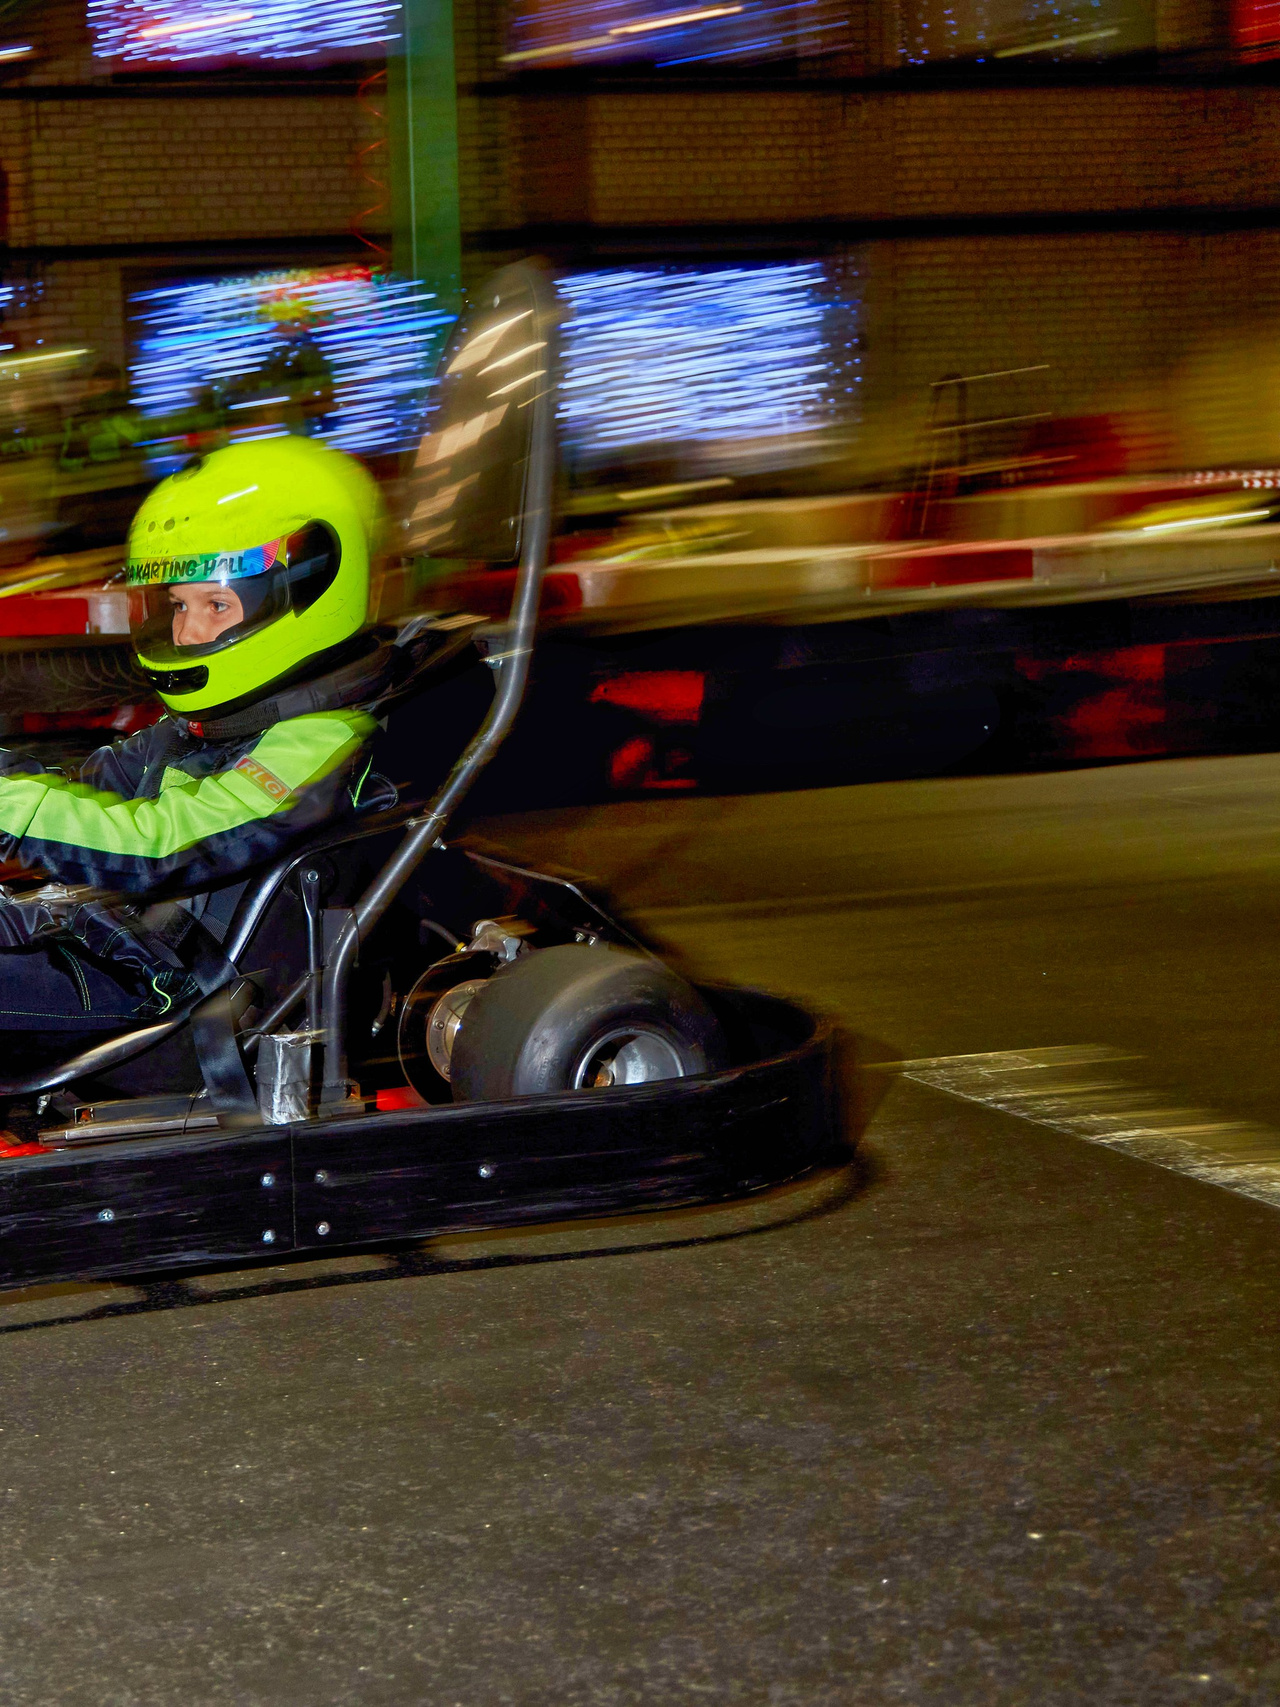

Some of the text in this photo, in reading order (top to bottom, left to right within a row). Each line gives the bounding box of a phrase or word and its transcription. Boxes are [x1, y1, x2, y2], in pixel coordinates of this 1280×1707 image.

[136, 559, 197, 581] KARTING
[203, 556, 248, 576] HALL
[238, 761, 283, 795] RLG
